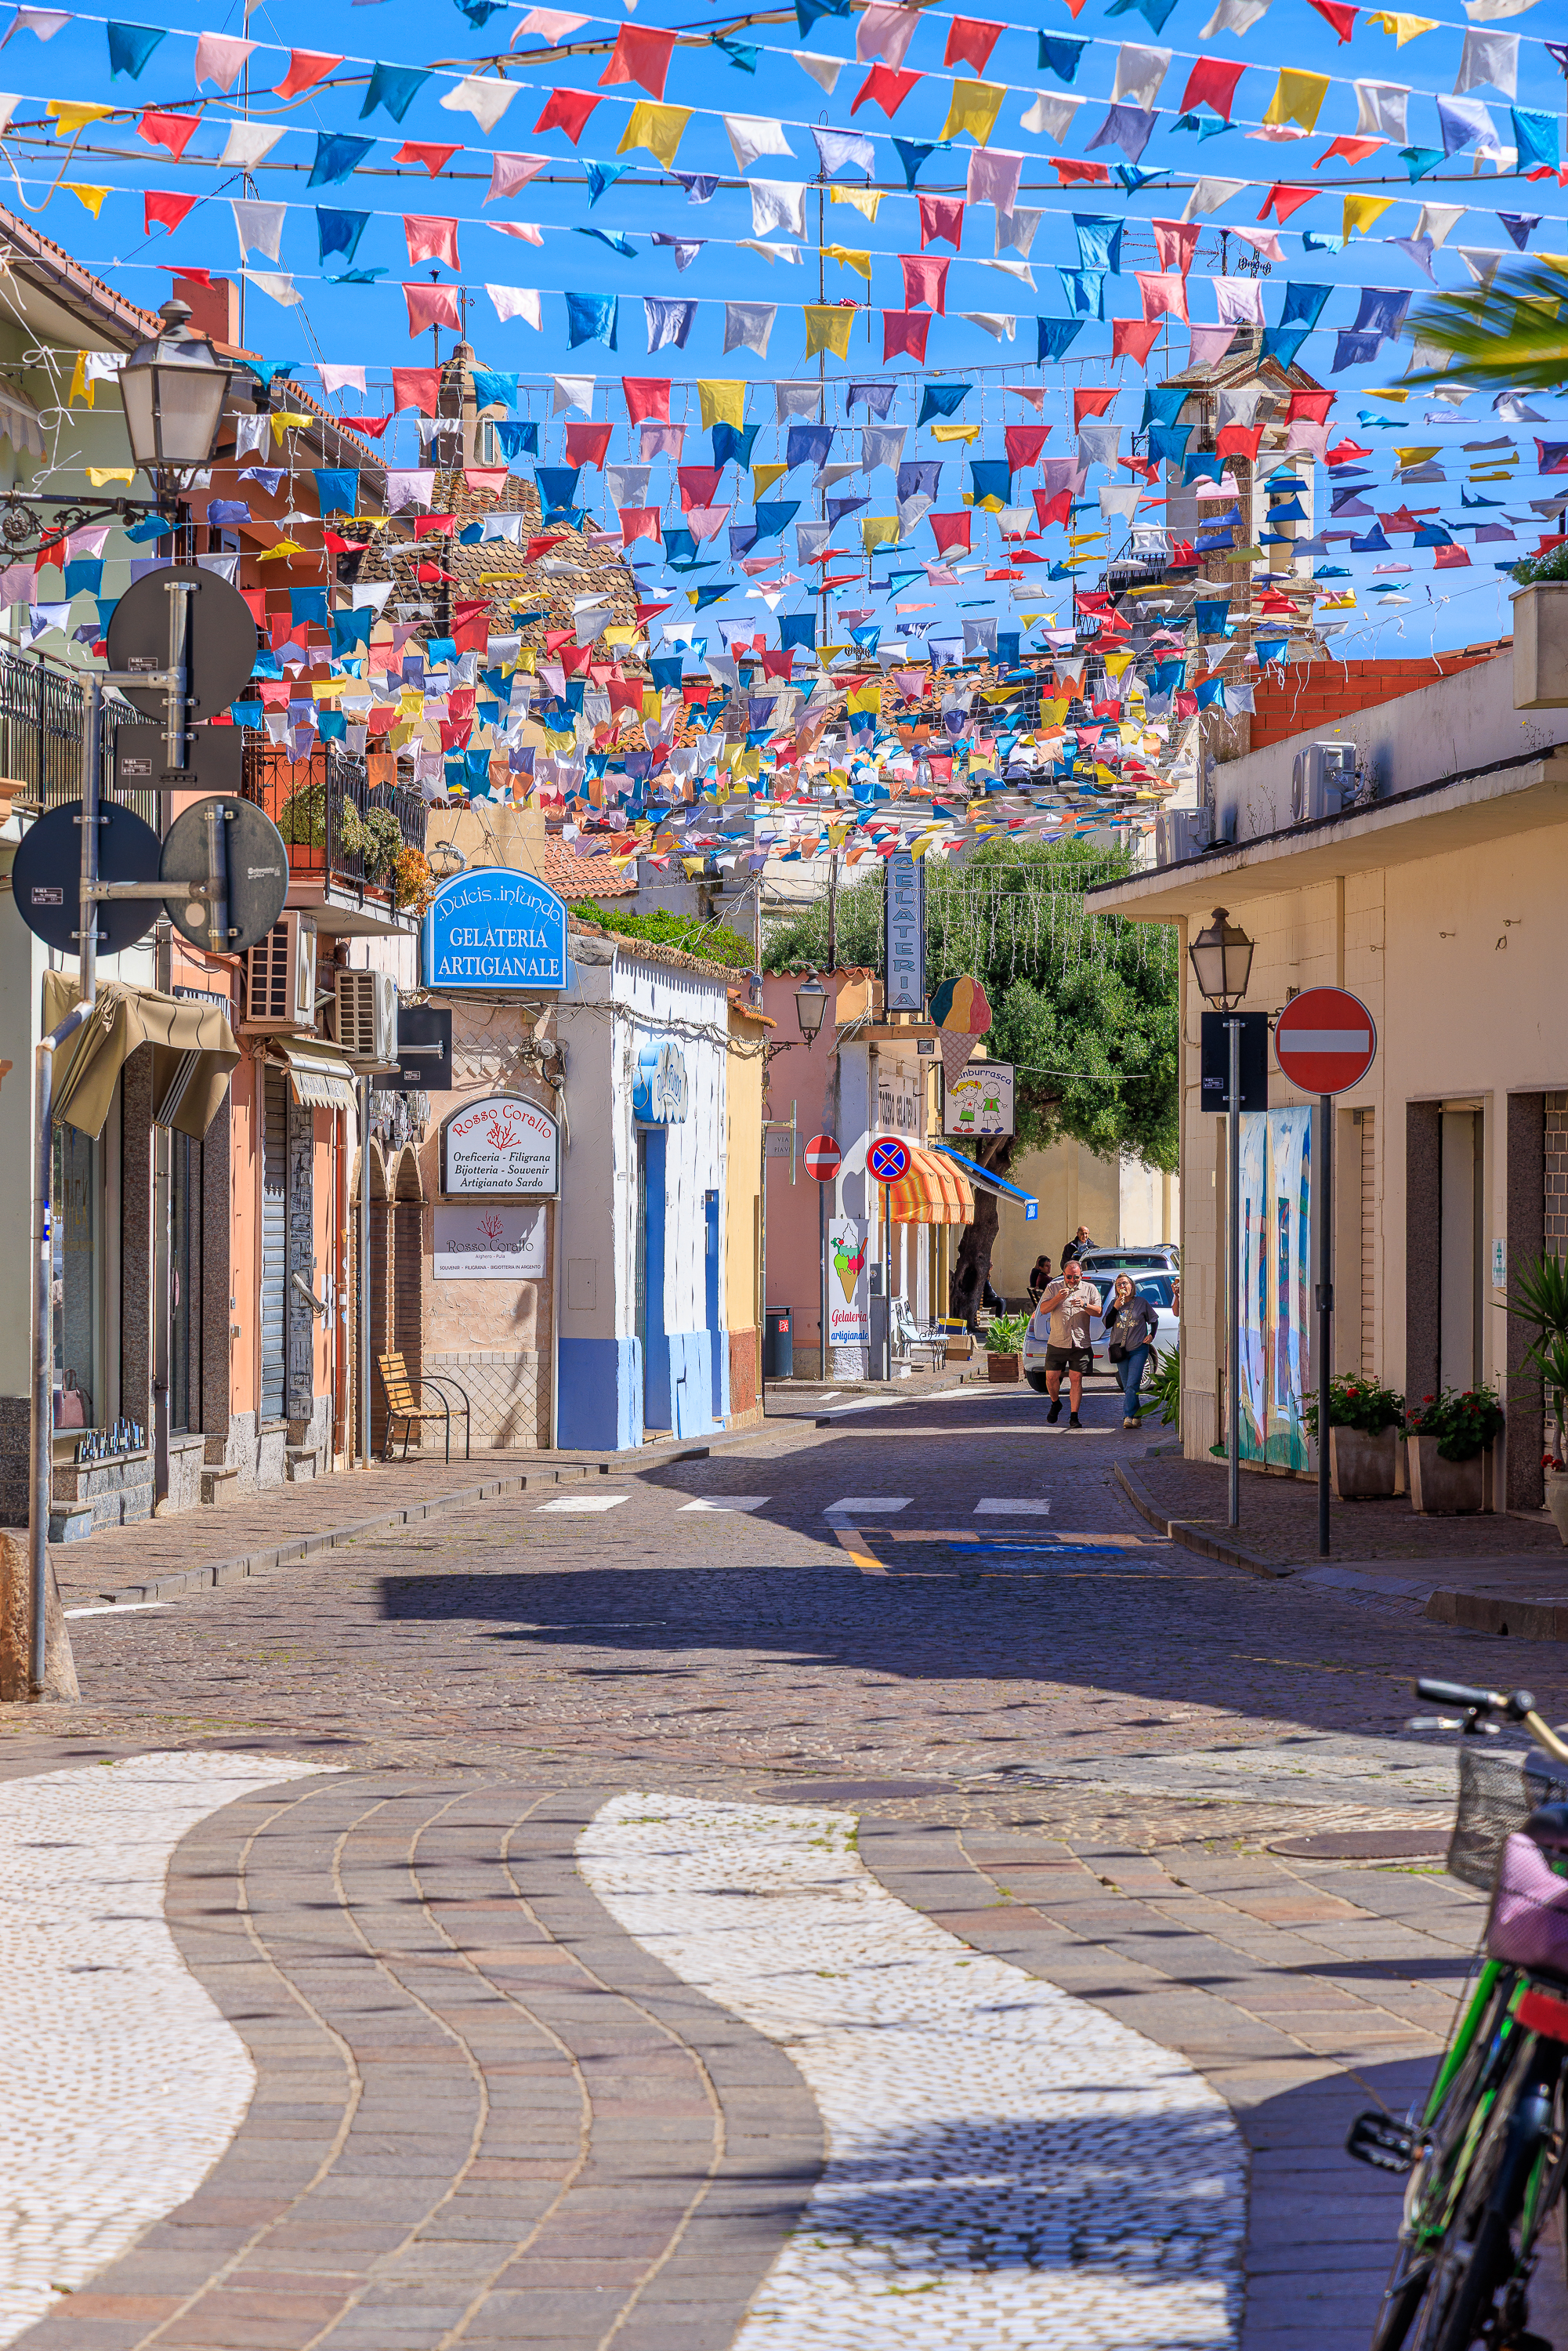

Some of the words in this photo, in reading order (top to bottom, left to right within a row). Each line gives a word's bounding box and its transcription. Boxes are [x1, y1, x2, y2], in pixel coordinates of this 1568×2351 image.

[450, 928, 548, 948] GELATERIA
[893, 857, 915, 1005] GELATERIA
[438, 955, 559, 977] ARTIGIANALE
[452, 1109, 498, 1137] Rosso
[502, 1104, 552, 1139] Corallo
[453, 1152, 499, 1162] Oreficeria
[509, 1151, 551, 1164] Filigrana
[454, 1165, 498, 1176] Bijotteria
[507, 1164, 549, 1175] Souvenir
[459, 1177, 513, 1189] Artigianato
[515, 1177, 543, 1187] Sardo
[446, 1239, 486, 1253] Rosso
[489, 1238, 534, 1253] Corallo
[831, 1309, 868, 1328] Gelateria
[831, 1329, 869, 1344] artigianale
